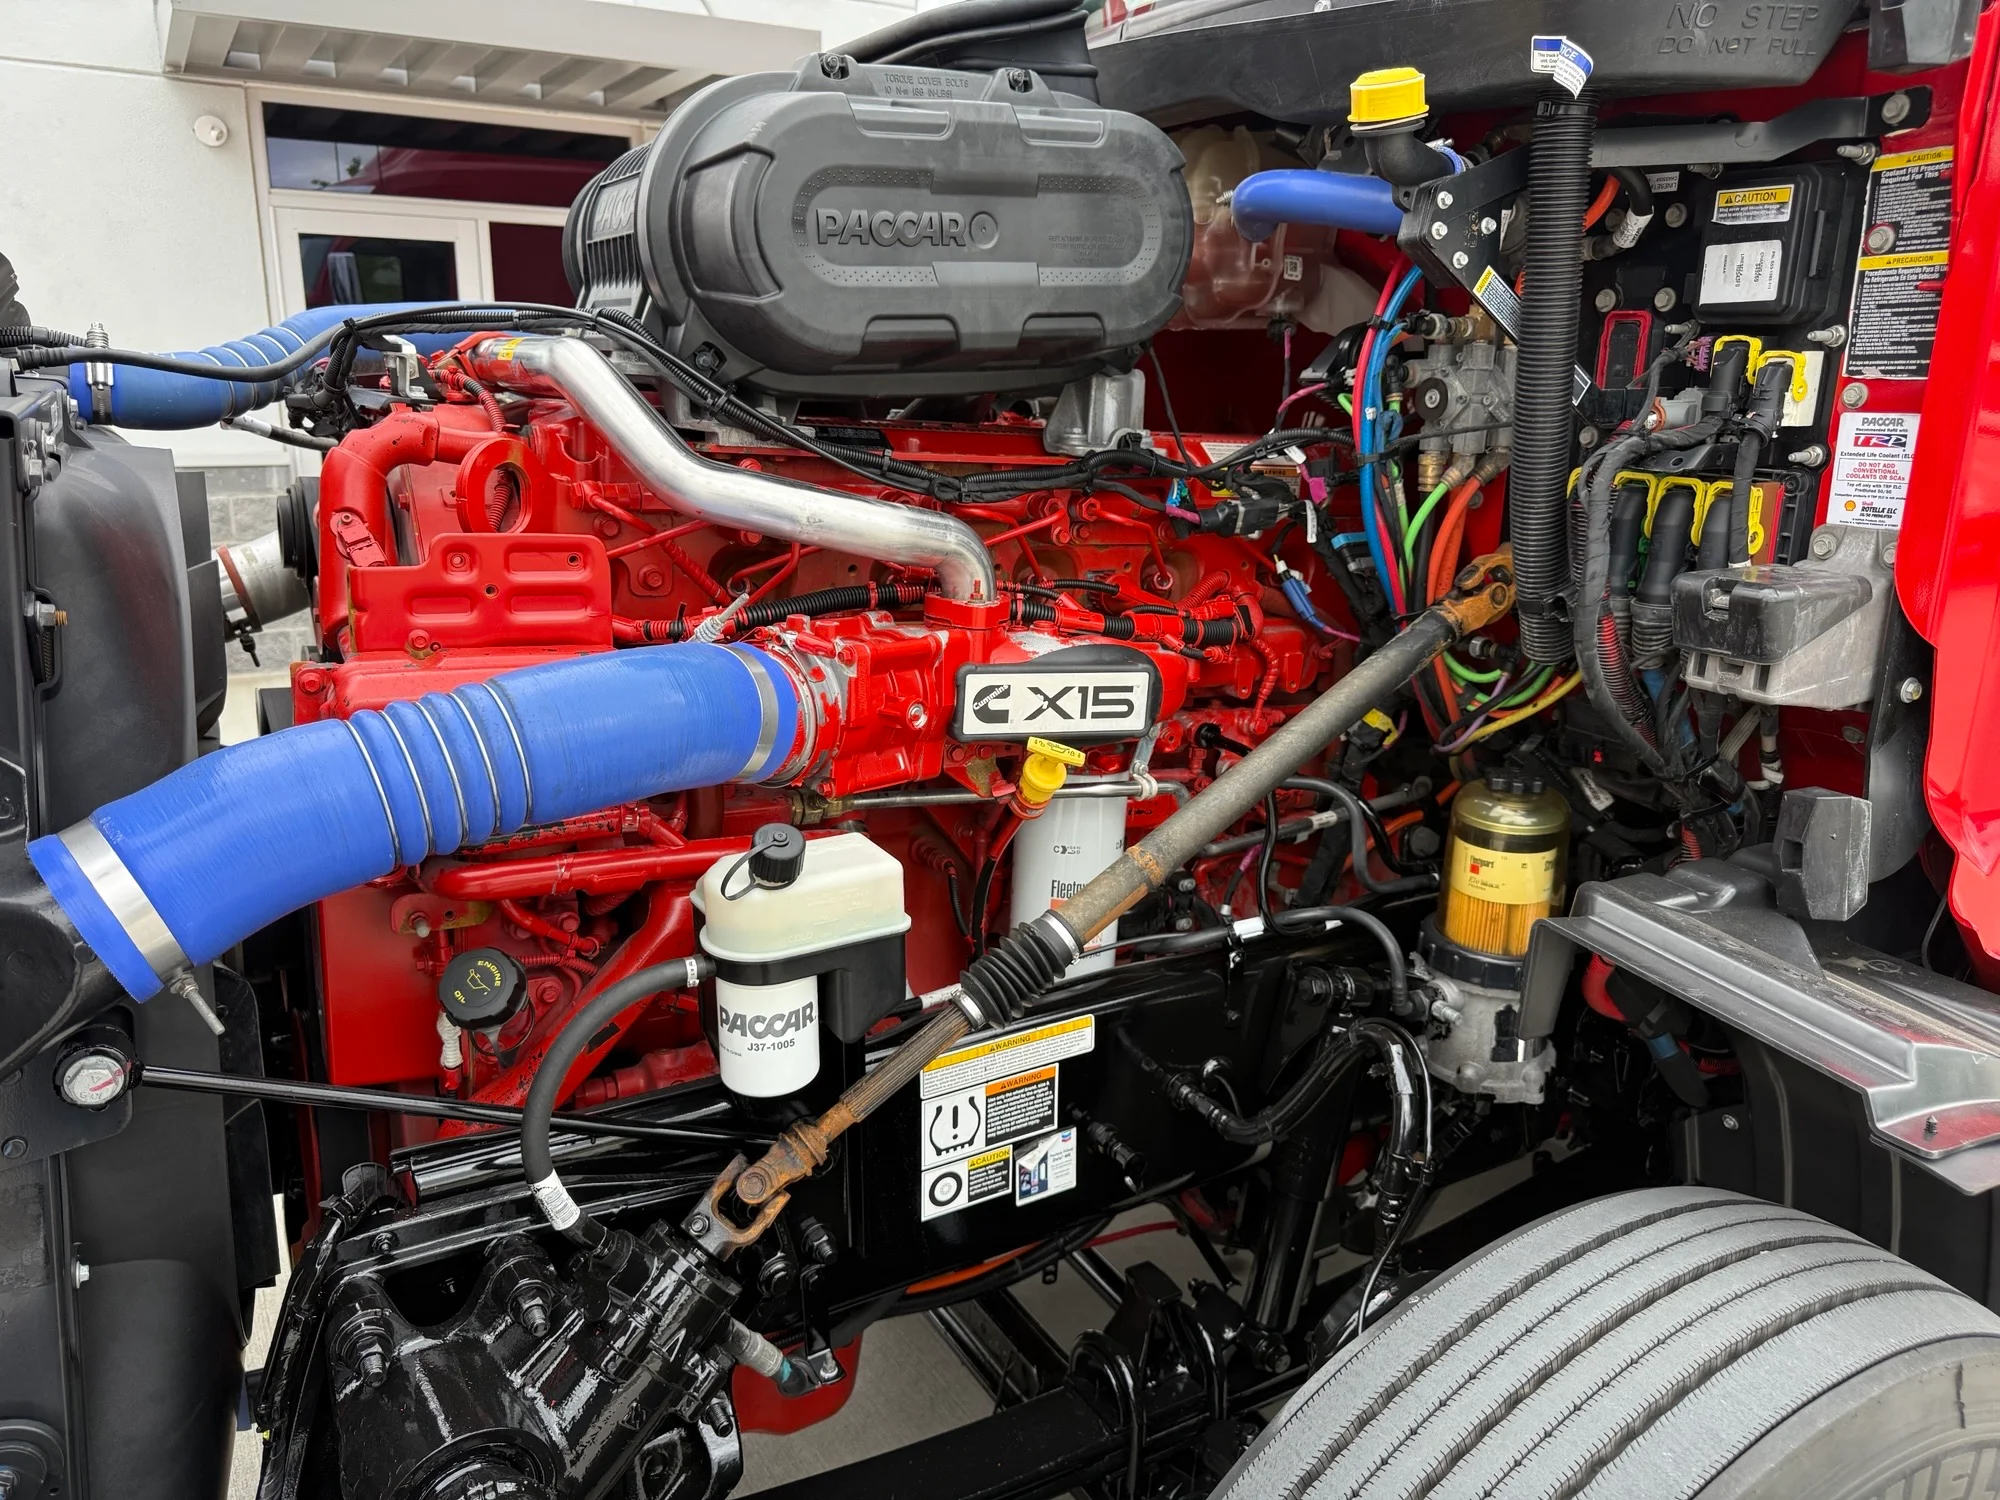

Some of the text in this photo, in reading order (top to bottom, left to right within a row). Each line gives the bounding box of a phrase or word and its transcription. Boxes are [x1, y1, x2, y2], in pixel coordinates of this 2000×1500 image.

[1667, 3, 1819, 30] NO STEP
[1658, 36, 1817, 55] DO NOT PULL
[885, 74, 968, 88] TORQUE COVER BOLTS
[1912, 152, 1941, 162] CAUTION
[1881, 174, 1909, 184] Required
[1882, 168, 1906, 177] Coolant
[1734, 192, 1776, 203] CAUTION
[816, 209, 966, 247] PACCAR
[1898, 266, 1922, 274] Requerido
[1476, 270, 1493, 293] CAUTION
[1871, 274, 1899, 283] Refrigerante
[1862, 417, 1904, 426] PACCAR
[1855, 434, 1907, 447] TRP
[973, 685, 1009, 711] Cummins
[1024, 685, 1134, 721] X15
[1051, 880, 1087, 898] Fleet
[477, 960, 502, 987] ENGINE
[454, 990, 465, 1004] OIL
[720, 1001, 814, 1039] PACCAR
[747, 1038, 795, 1052] J37-1005
[995, 1035, 1030, 1050] WARNING
[1006, 1072, 1041, 1087] WARNING
[976, 1150, 1009, 1165] CAUTION
